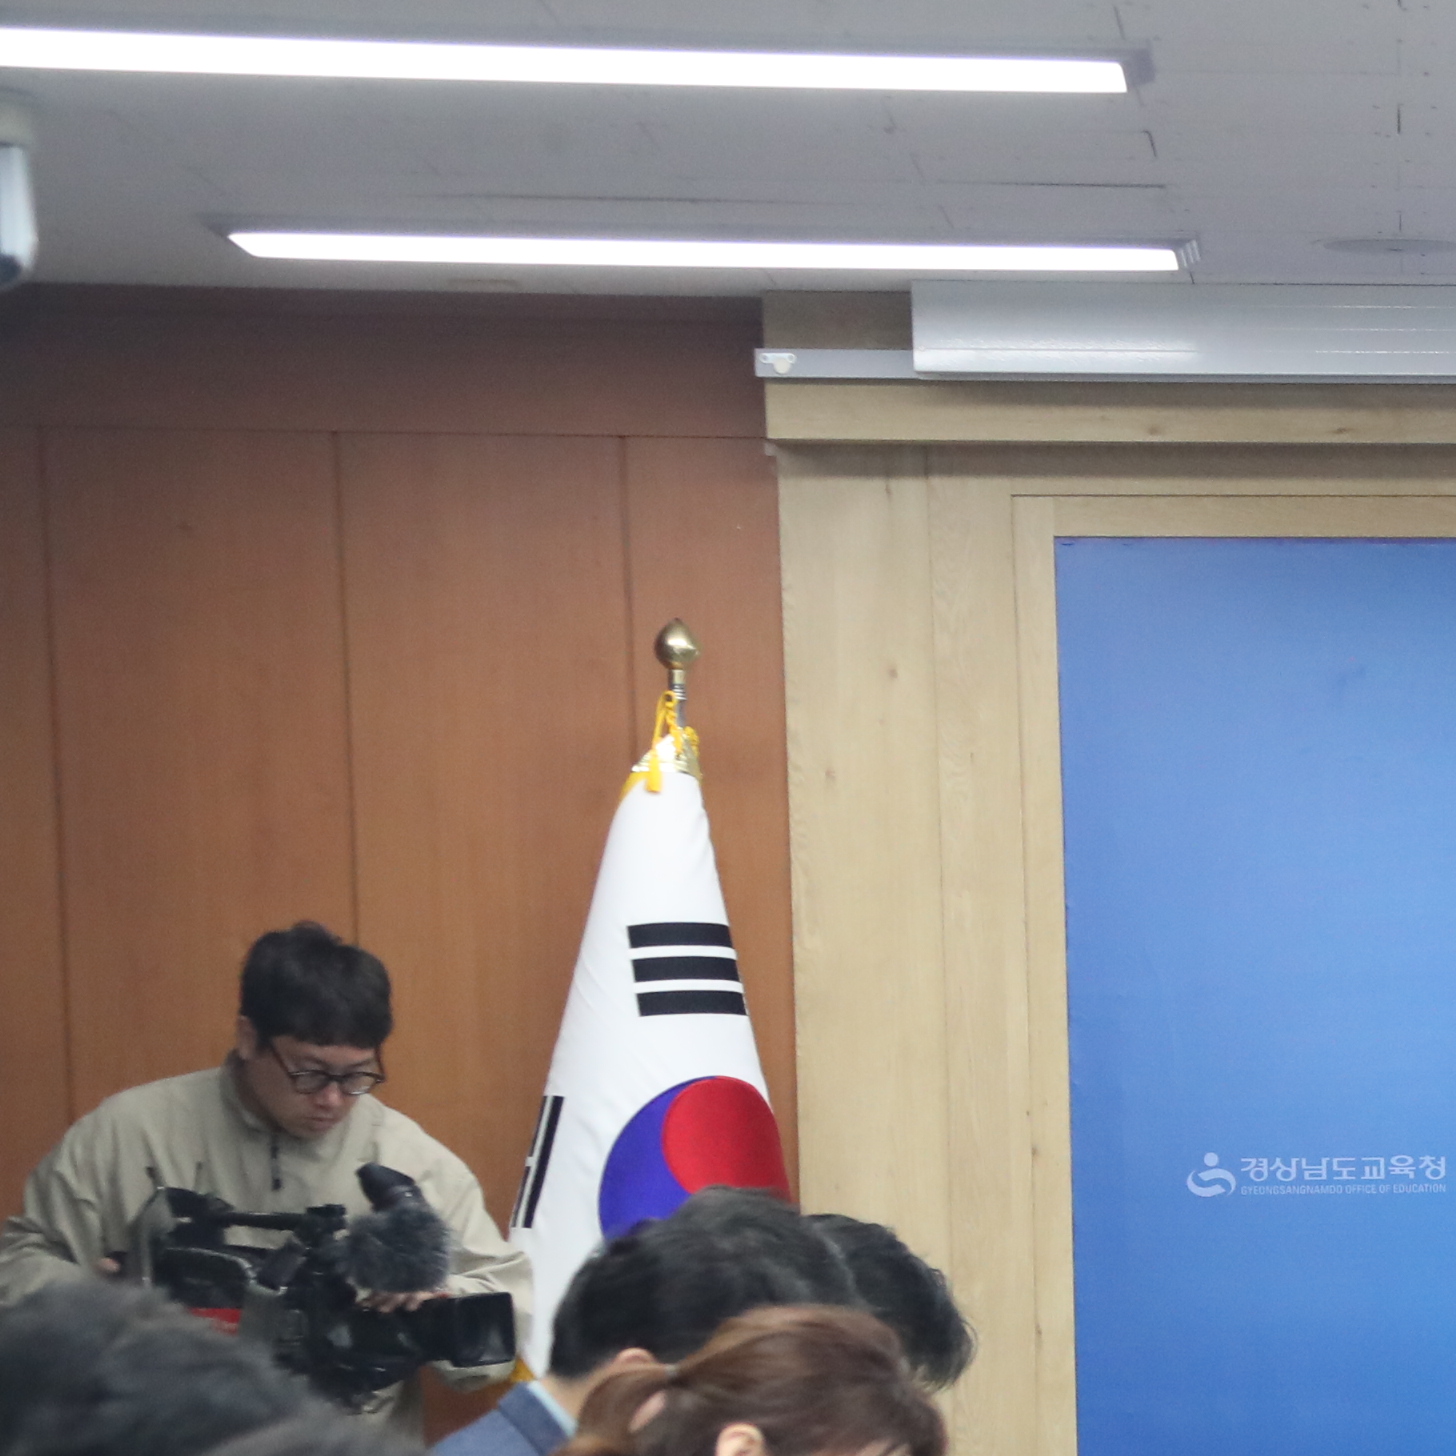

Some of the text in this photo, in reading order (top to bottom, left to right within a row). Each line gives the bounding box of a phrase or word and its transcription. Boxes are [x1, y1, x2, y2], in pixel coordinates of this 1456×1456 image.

[1241, 1155, 1446, 1182] 경상남도교육청
[1345, 1184, 1377, 1195] OFFICE
[1379, 1184, 1391, 1194] OF
[1393, 1183, 1446, 1194] EDUCATION
